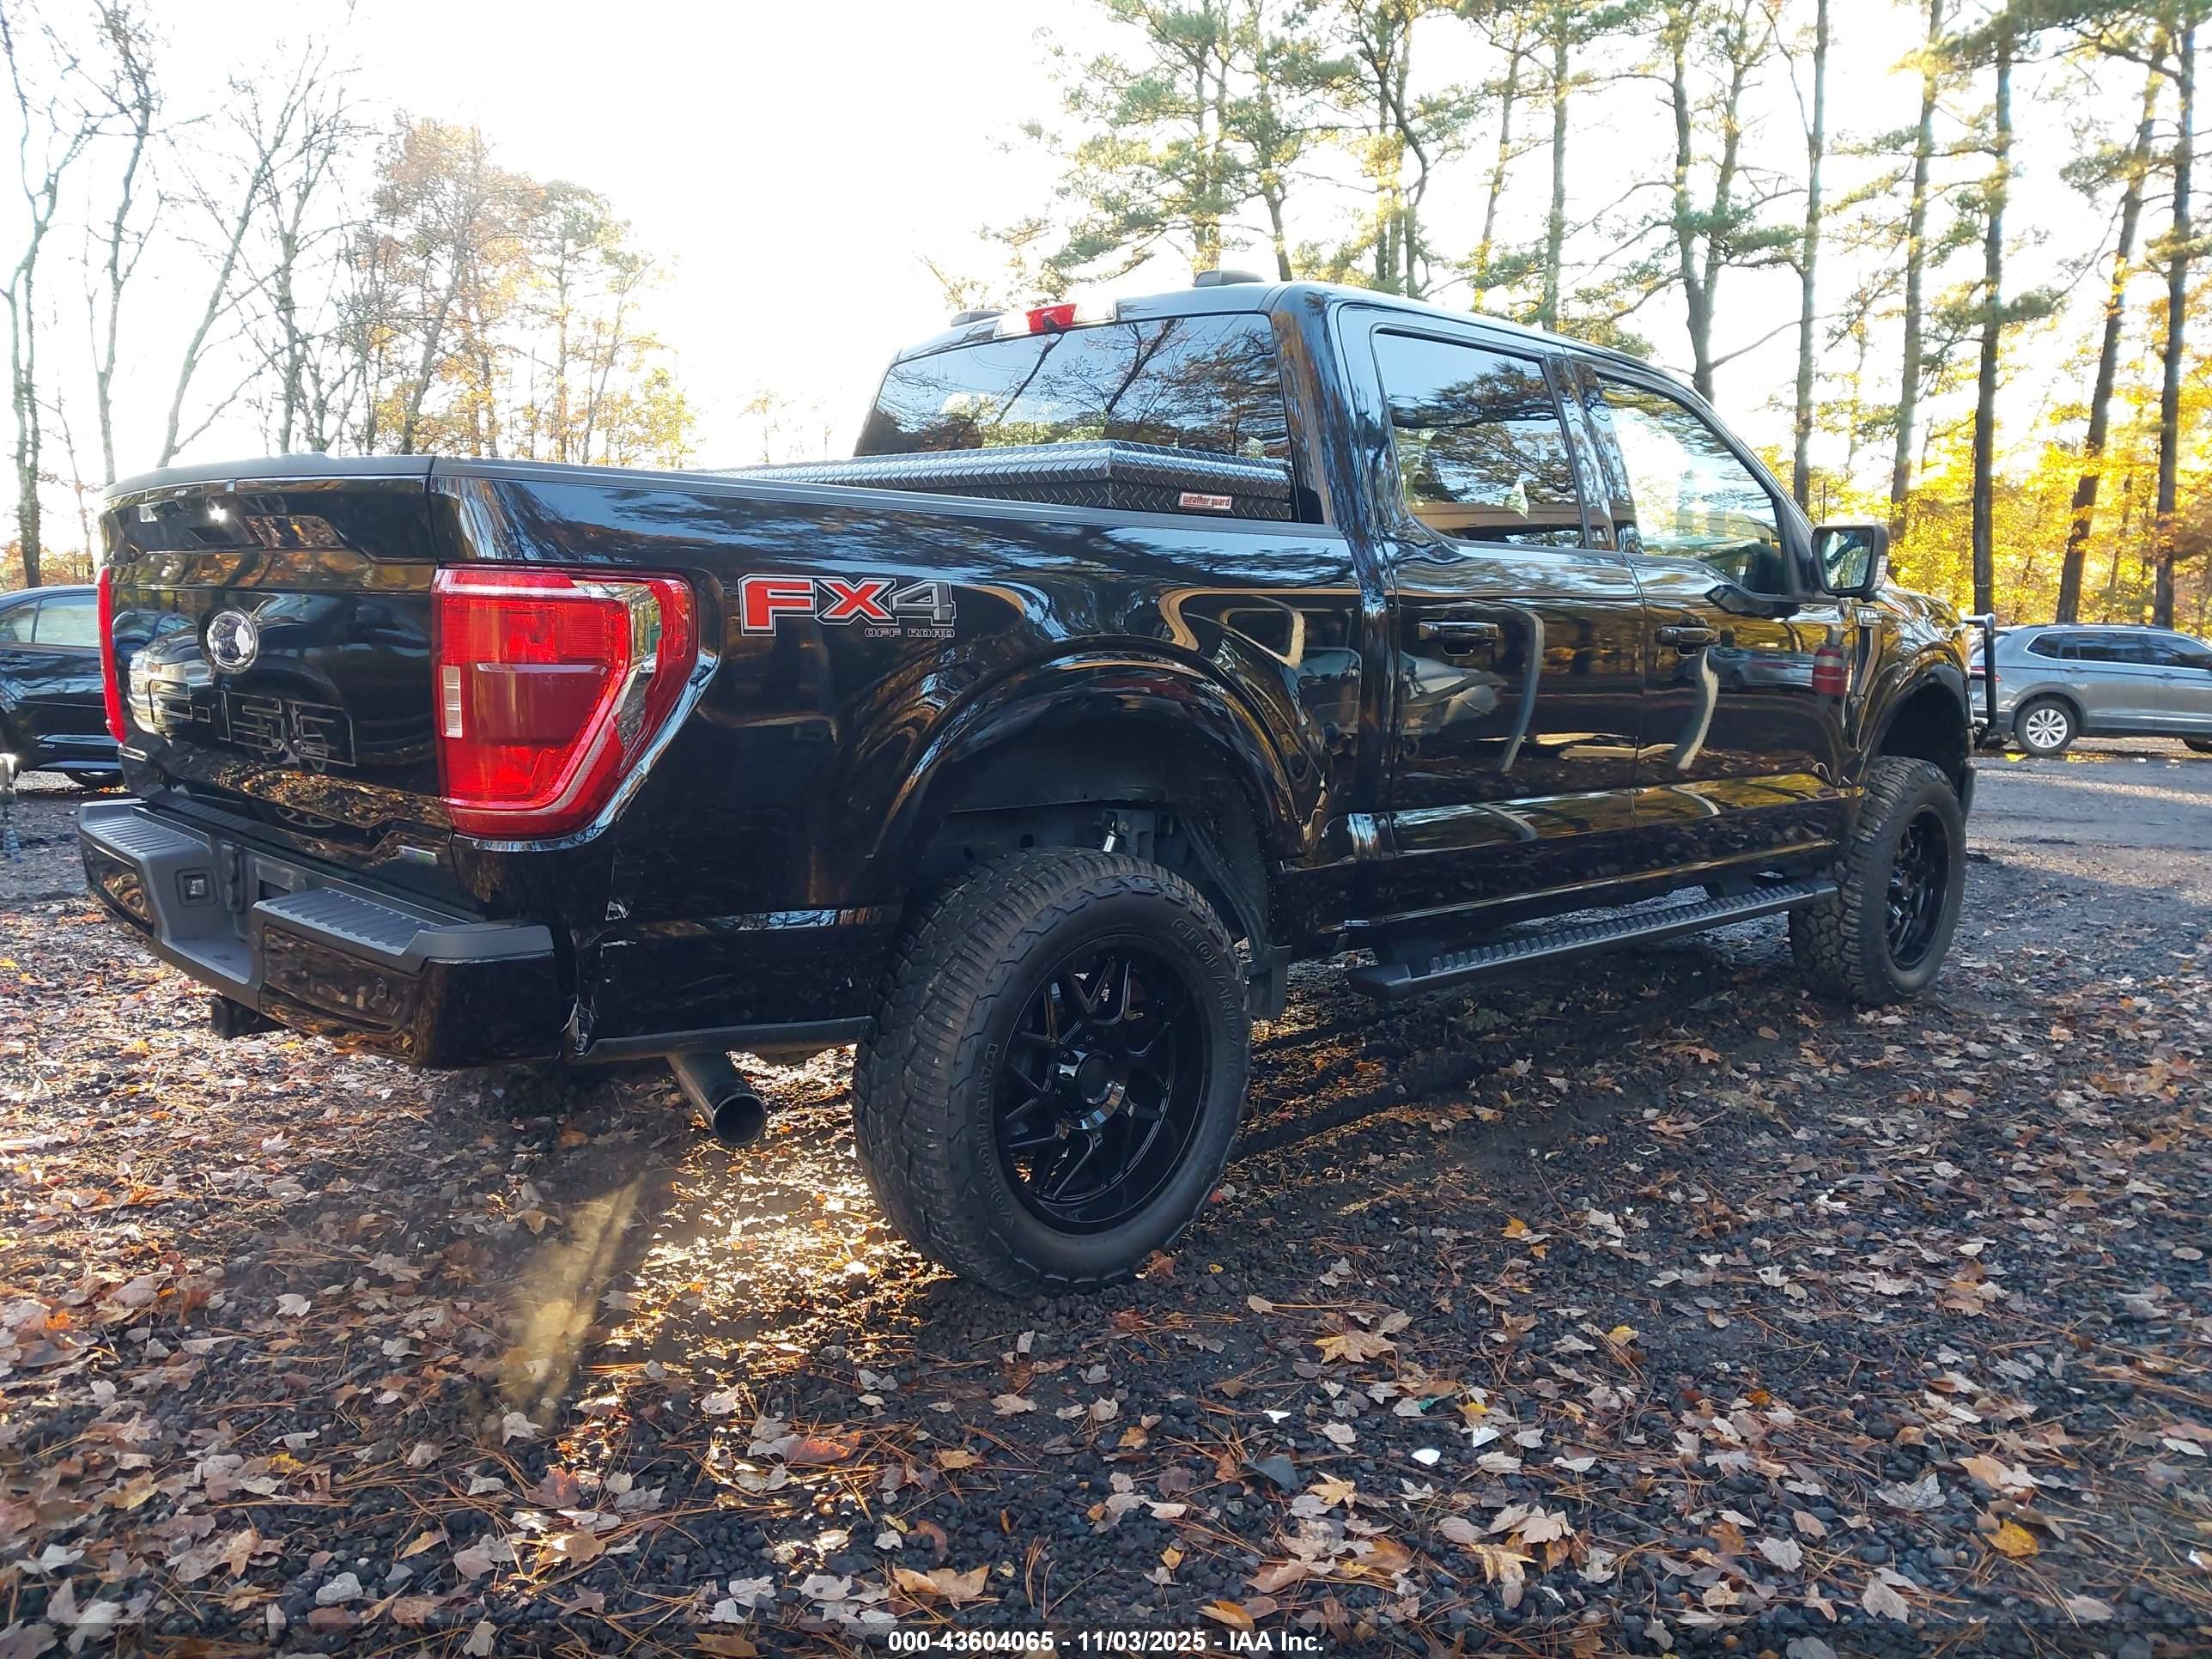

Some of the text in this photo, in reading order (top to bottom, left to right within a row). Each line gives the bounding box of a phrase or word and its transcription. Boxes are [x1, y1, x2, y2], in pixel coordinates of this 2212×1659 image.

[1182, 495, 1231, 508] weather guard
[738, 573, 957, 637] FX4
[864, 627, 956, 639] OFF ROAD
